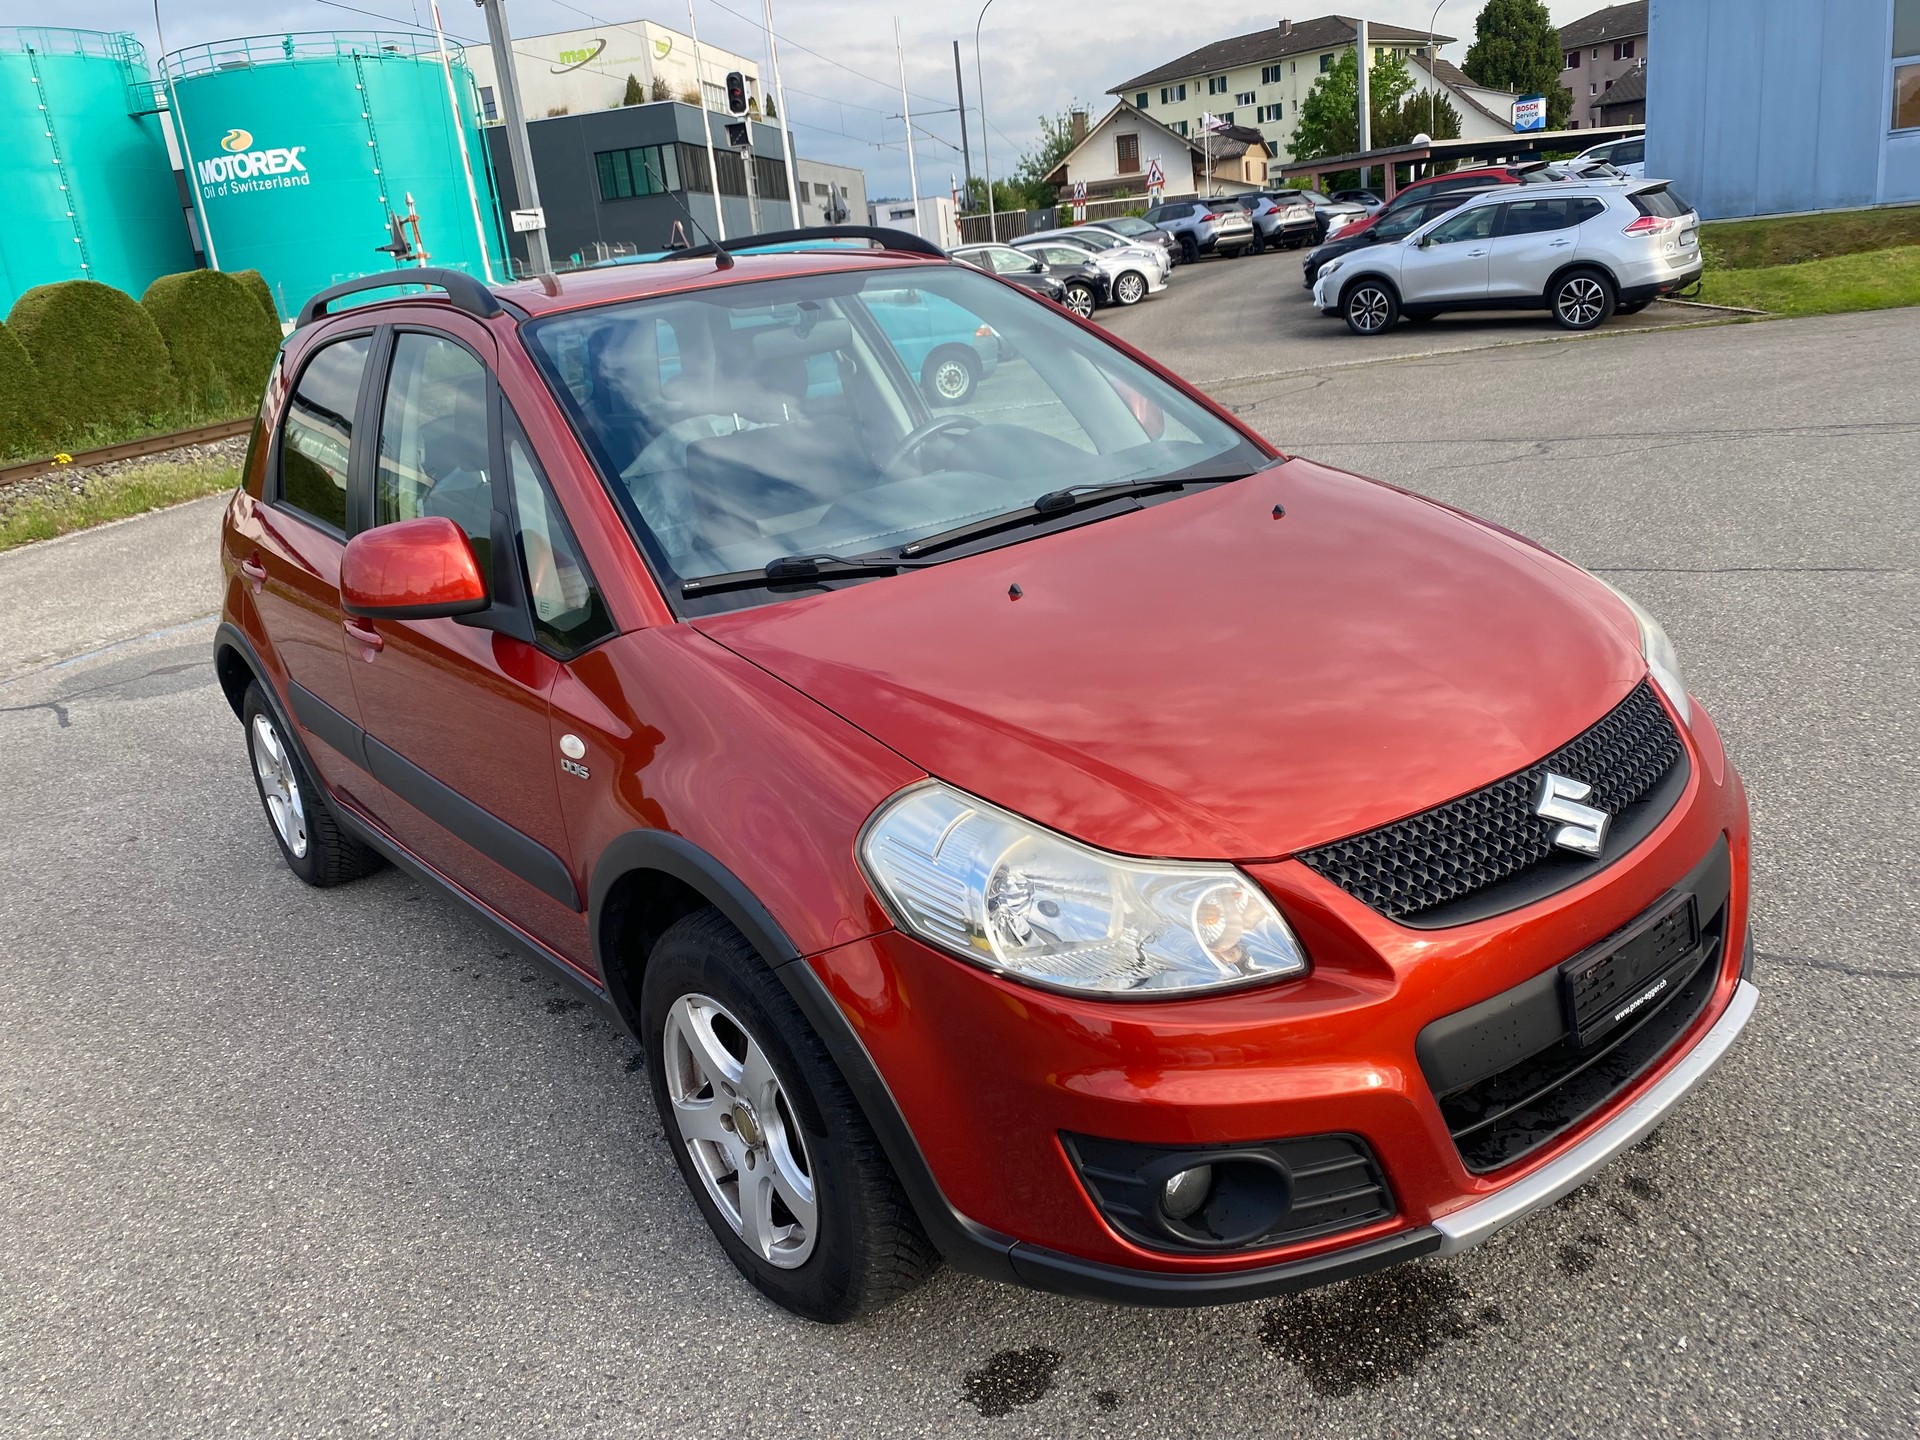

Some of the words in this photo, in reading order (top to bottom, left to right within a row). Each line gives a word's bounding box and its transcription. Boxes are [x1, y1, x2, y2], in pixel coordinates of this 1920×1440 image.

[1516, 103, 1539, 112] BOSCH
[1516, 111, 1539, 119] Service
[203, 185, 216, 199] Oil
[217, 182, 229, 197] of
[230, 172, 310, 194] Switzerland
[1614, 978, 1668, 1022] www.pneu-egger.ch
